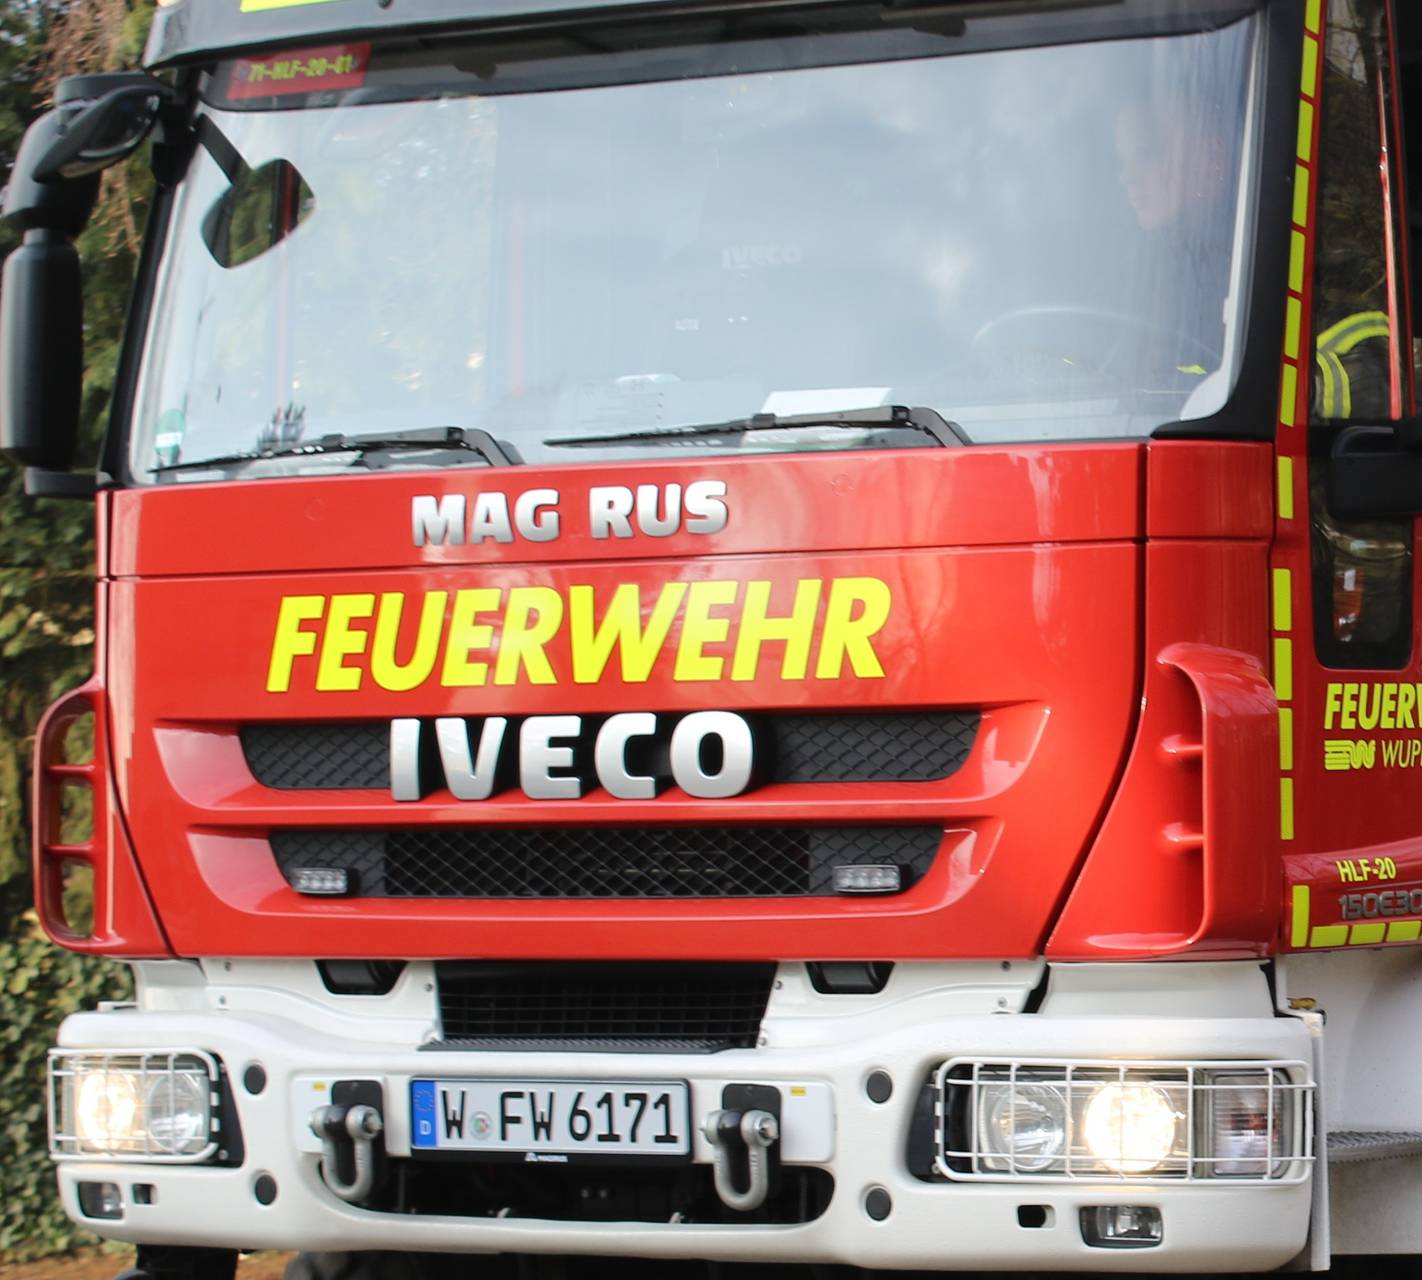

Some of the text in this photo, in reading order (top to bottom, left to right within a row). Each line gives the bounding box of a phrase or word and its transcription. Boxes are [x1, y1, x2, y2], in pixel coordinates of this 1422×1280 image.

[411, 480, 728, 547] MAG RUS
[266, 576, 892, 692] FEUERWEHR
[390, 710, 754, 801] IVECO
[1335, 857, 1397, 883] HLF-20
[419, 1120, 432, 1135] D
[441, 1089, 679, 1145] W FW 6171
